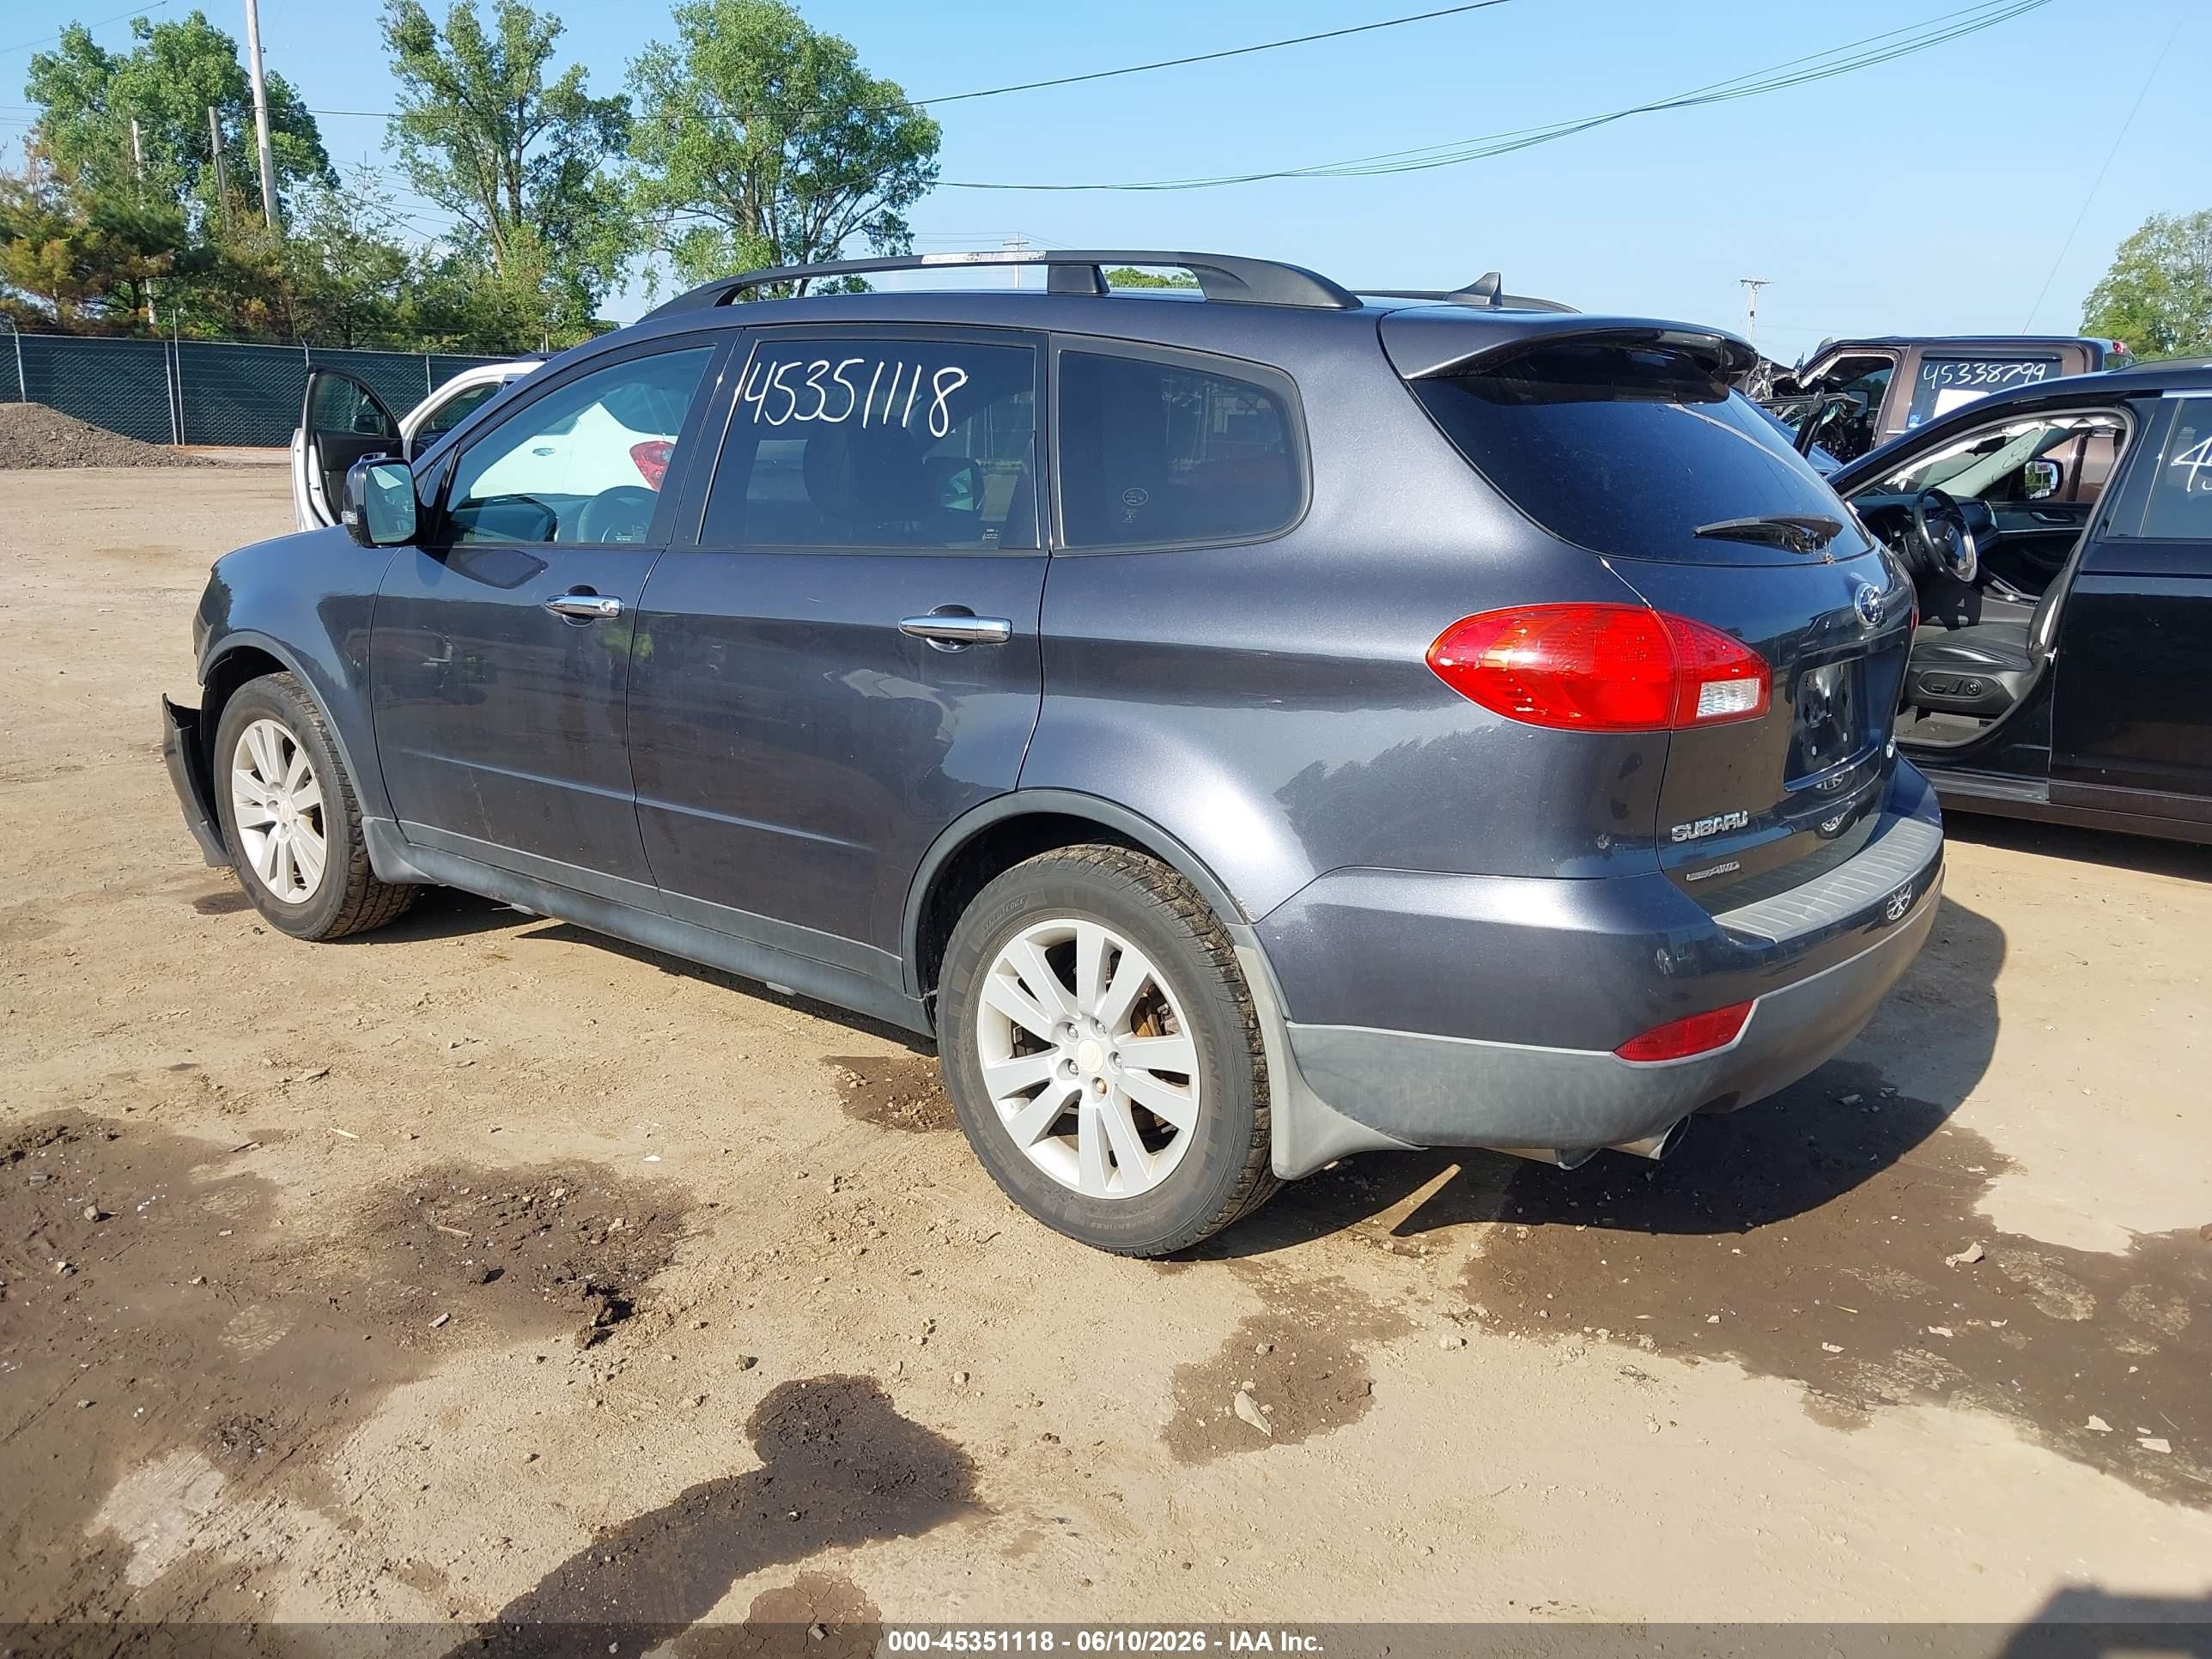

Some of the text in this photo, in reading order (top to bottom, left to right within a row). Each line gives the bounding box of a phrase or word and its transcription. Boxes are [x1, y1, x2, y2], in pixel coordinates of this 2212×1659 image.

[1923, 362, 2047, 390] 45338799
[744, 357, 969, 438] 45351118
[1671, 810, 1749, 842] SUBARU
